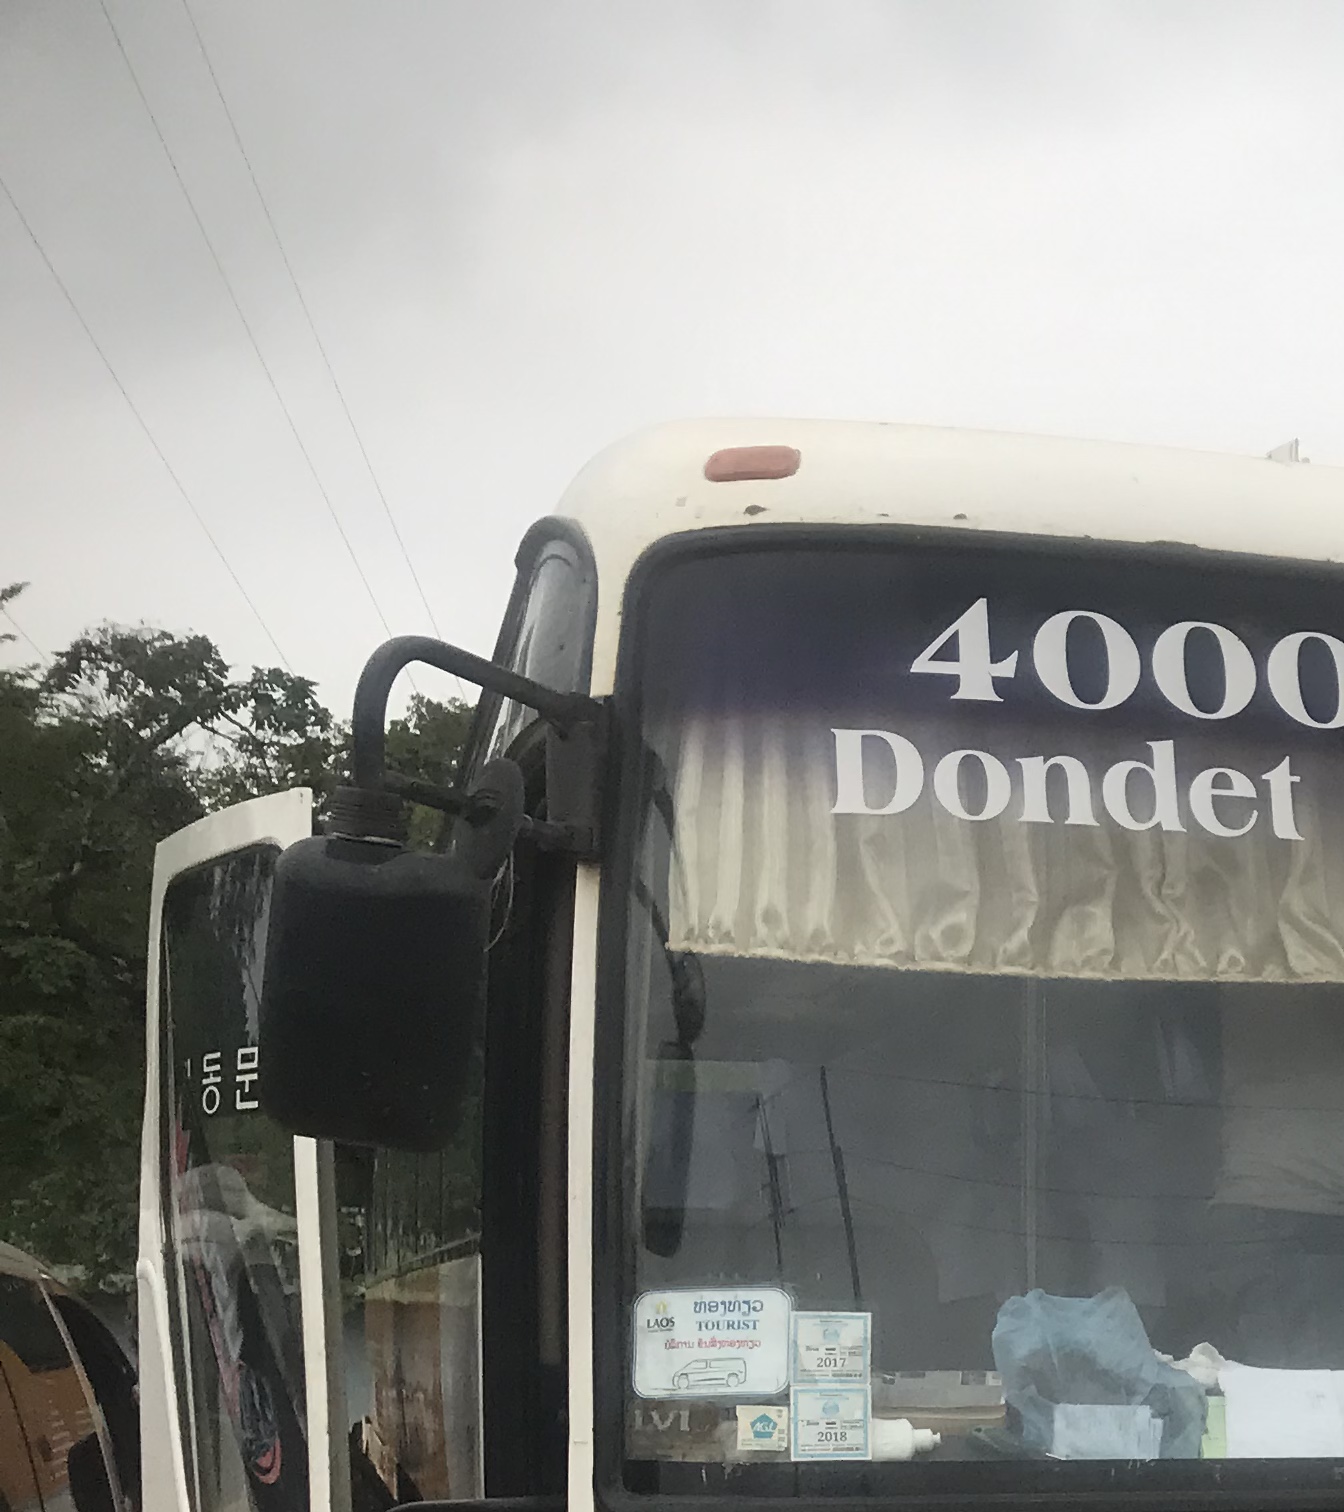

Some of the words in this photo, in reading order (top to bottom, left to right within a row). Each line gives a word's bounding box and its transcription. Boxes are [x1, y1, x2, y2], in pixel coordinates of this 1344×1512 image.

[831, 728, 1305, 841] Dondet
[646, 1317, 675, 1329] LAOS
[696, 1319, 760, 1331] TOURIST
[816, 1357, 847, 1368] 2017
[817, 1431, 848, 1442] 2018
